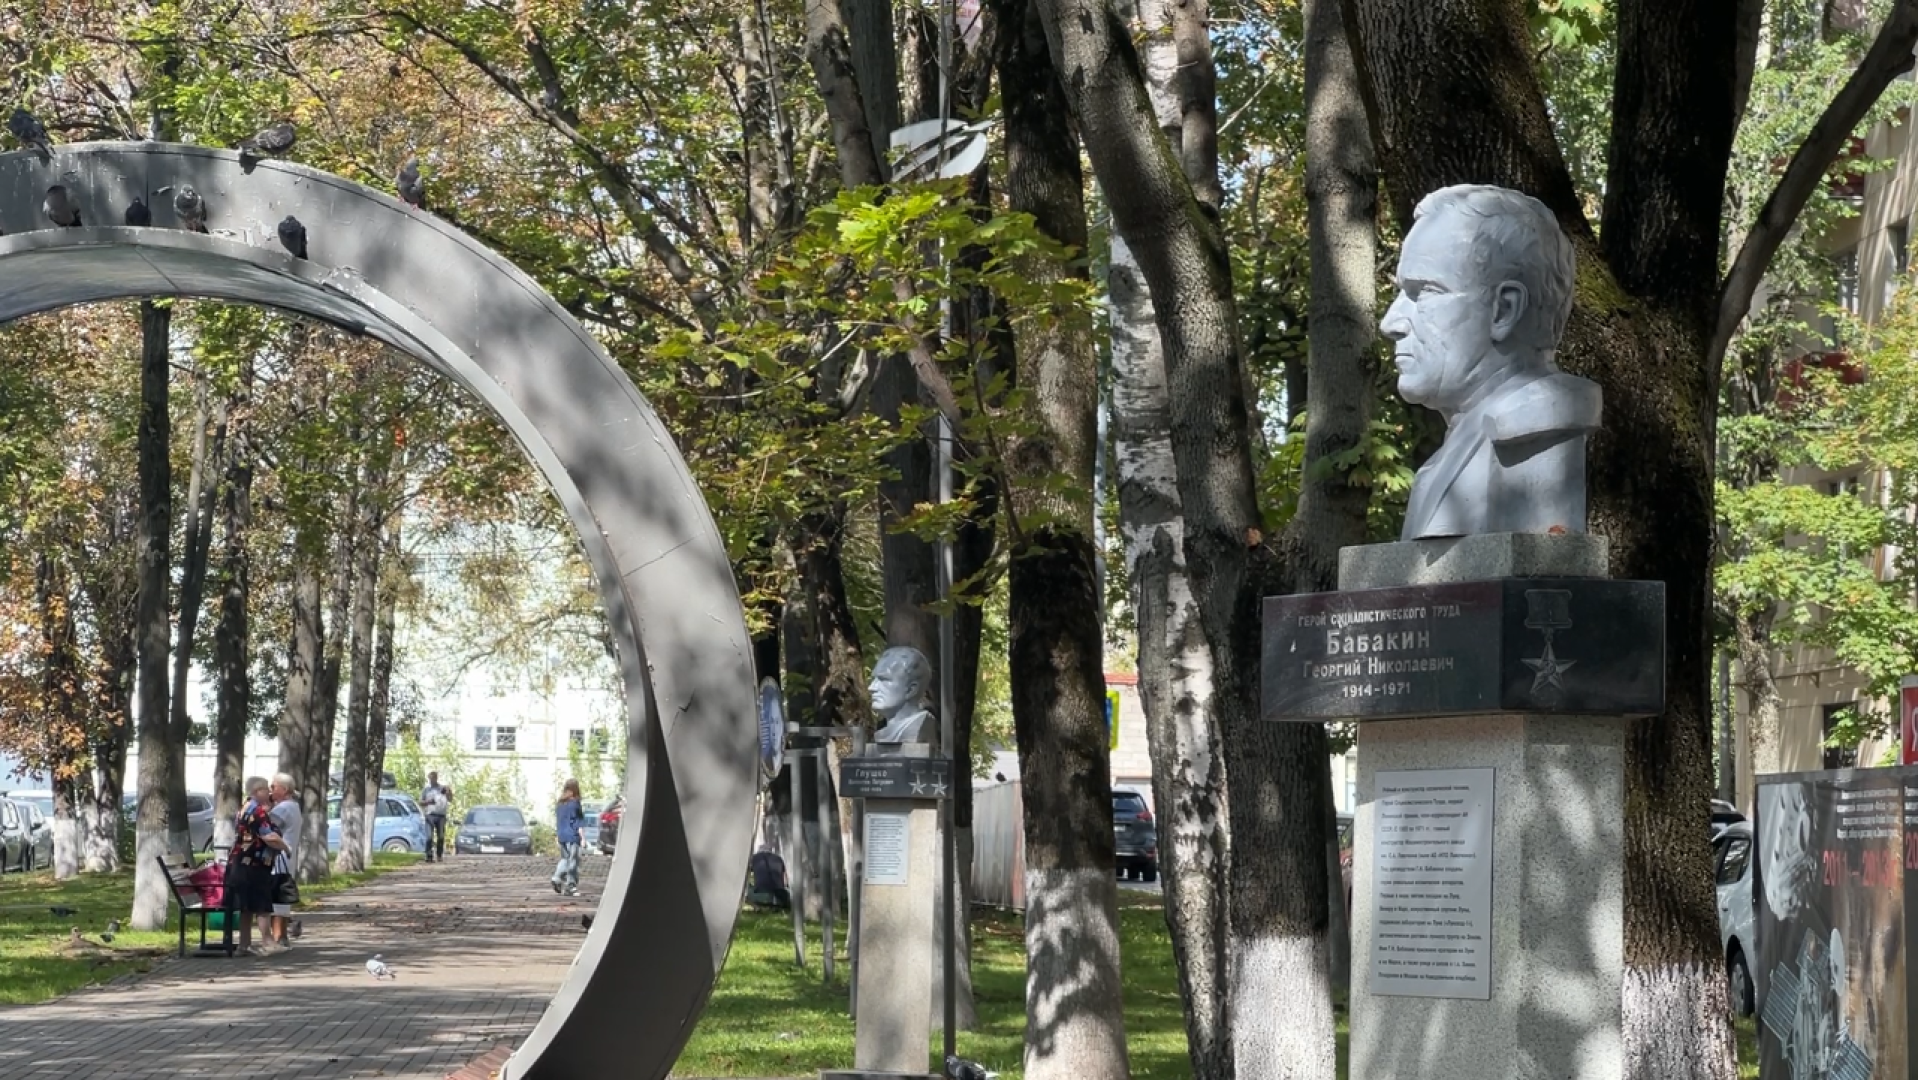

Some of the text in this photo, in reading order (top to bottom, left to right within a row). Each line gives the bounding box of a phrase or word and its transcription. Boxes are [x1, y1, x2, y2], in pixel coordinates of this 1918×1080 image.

[1298, 611, 1327, 627] ГЕРОЙ
[1432, 604, 1461, 617] ТРУДА
[1303, 656, 1454, 678] Георгий Николаевич
[1342, 681, 1411, 698] 1914-1971
